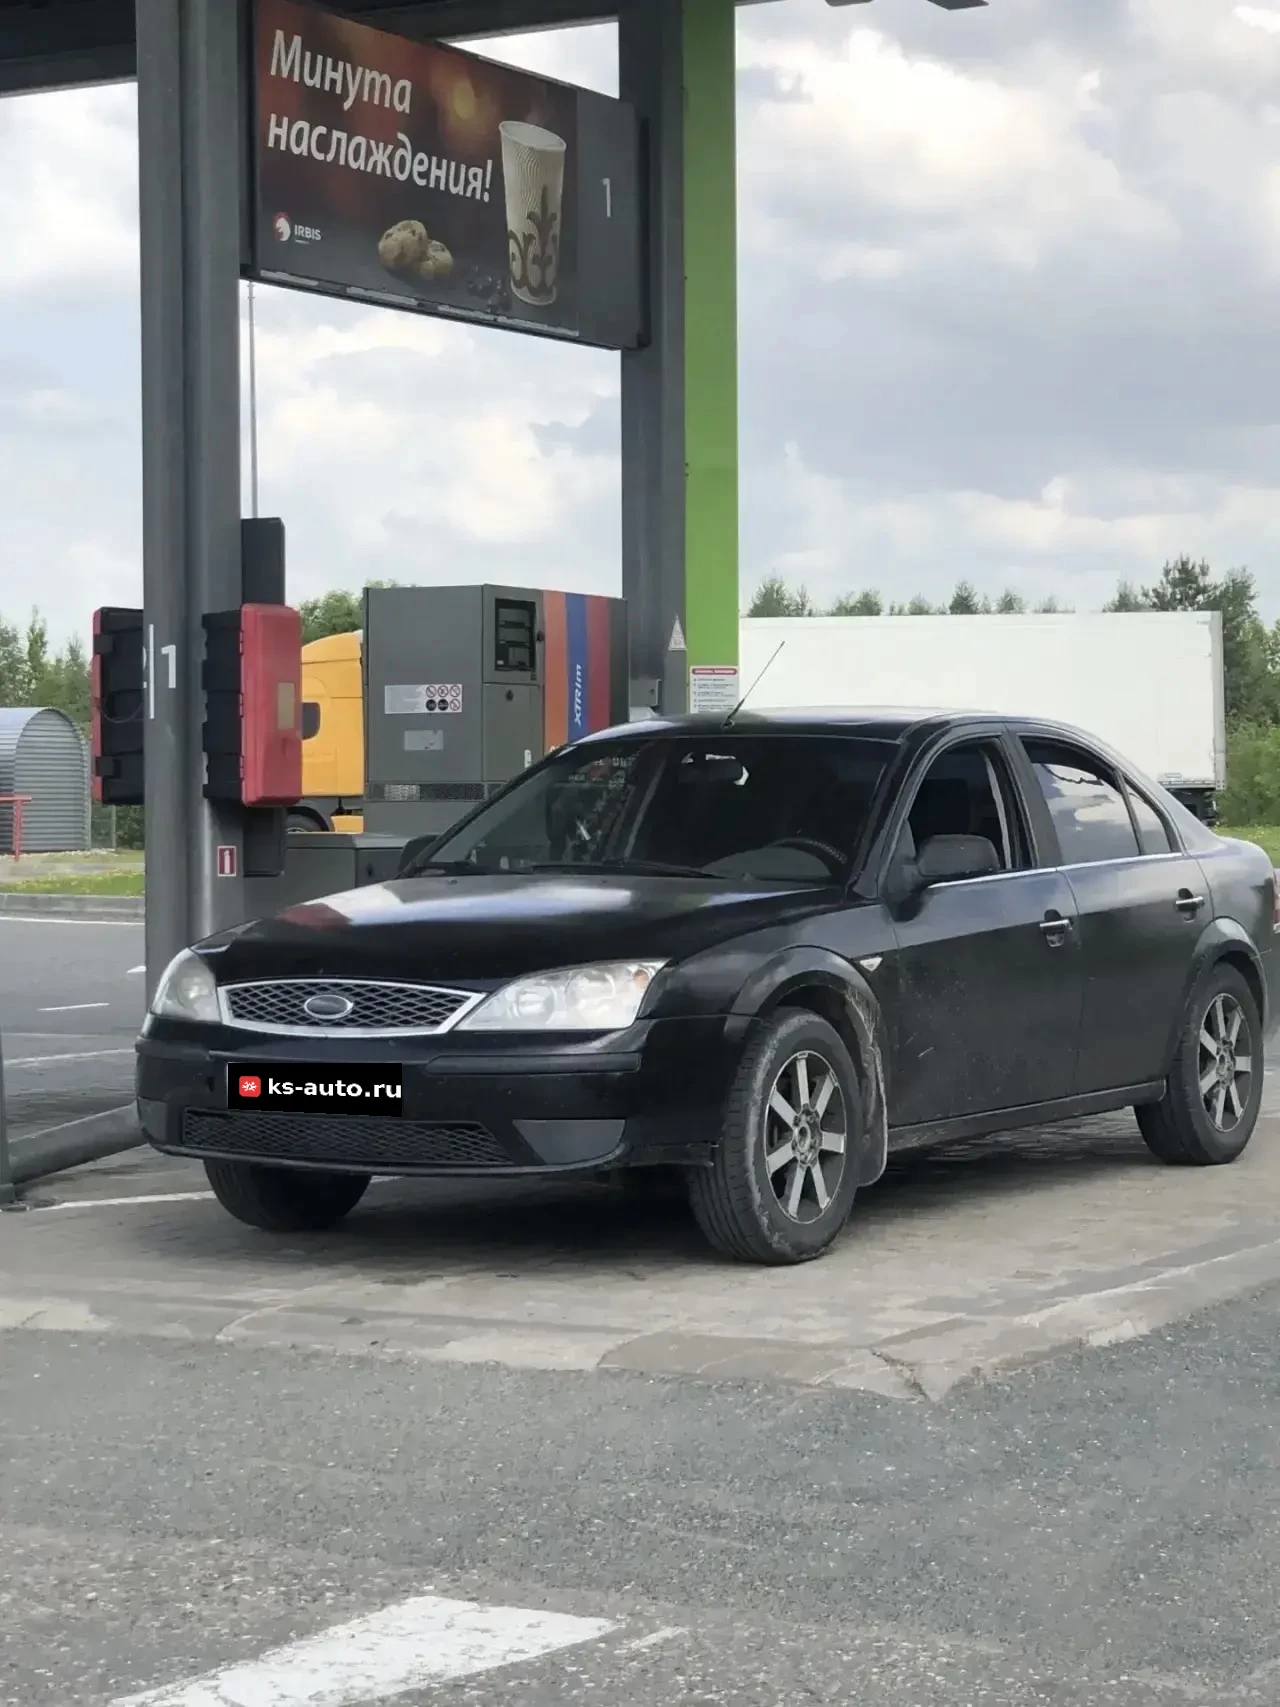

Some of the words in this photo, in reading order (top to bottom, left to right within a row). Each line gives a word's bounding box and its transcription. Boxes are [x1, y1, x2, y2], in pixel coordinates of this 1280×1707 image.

[270, 29, 412, 114] Минута
[267, 113, 493, 203] наслаждения!
[602, 177, 611, 218] 1
[294, 224, 322, 241] IRBIS
[161, 644, 177, 689] 1
